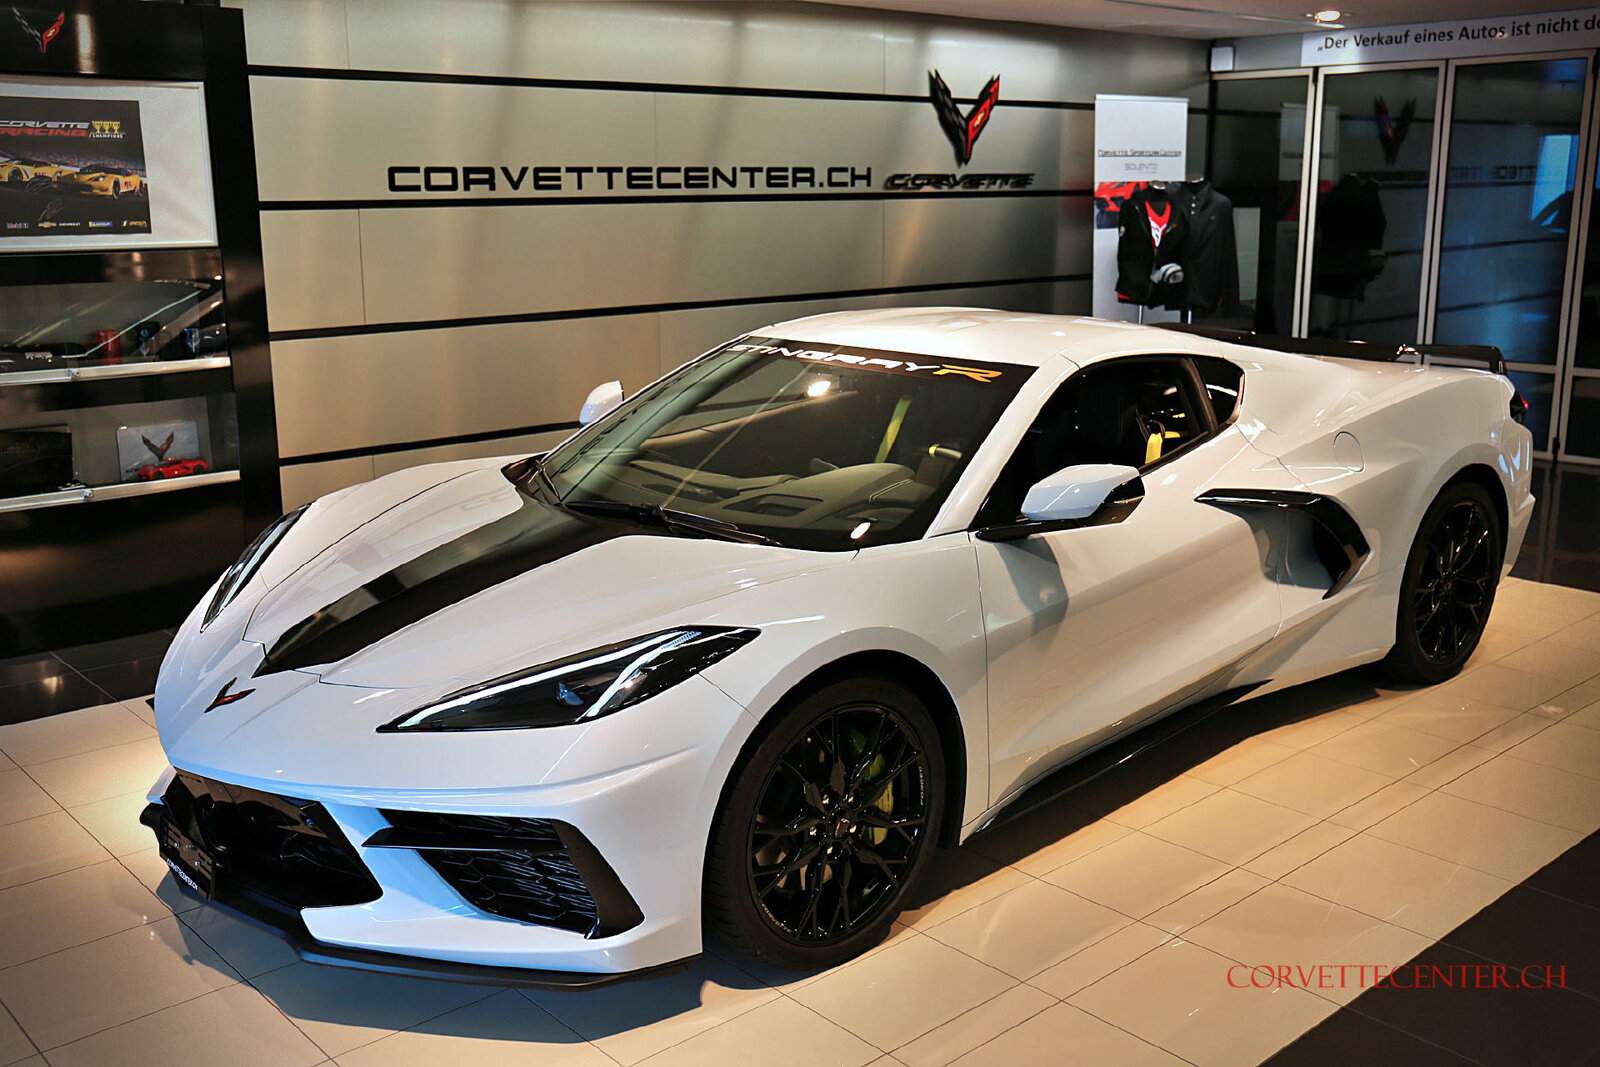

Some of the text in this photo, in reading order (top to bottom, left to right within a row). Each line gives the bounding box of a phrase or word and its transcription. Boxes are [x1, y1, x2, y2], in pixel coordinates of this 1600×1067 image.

[1354, 29, 1411, 47] Verkauf
[1414, 28, 1454, 43] eines
[1459, 24, 1506, 40] Autos
[1511, 21, 1531, 36] ist
[1536, 17, 1580, 34] nicht
[0, 120, 90, 128] CORVETTE
[0, 128, 87, 136] RACING
[388, 166, 872, 192] CORVETTECENTER.CH
[885, 173, 1035, 190] CORVETTE
[726, 344, 1002, 383] STINGRAY R
